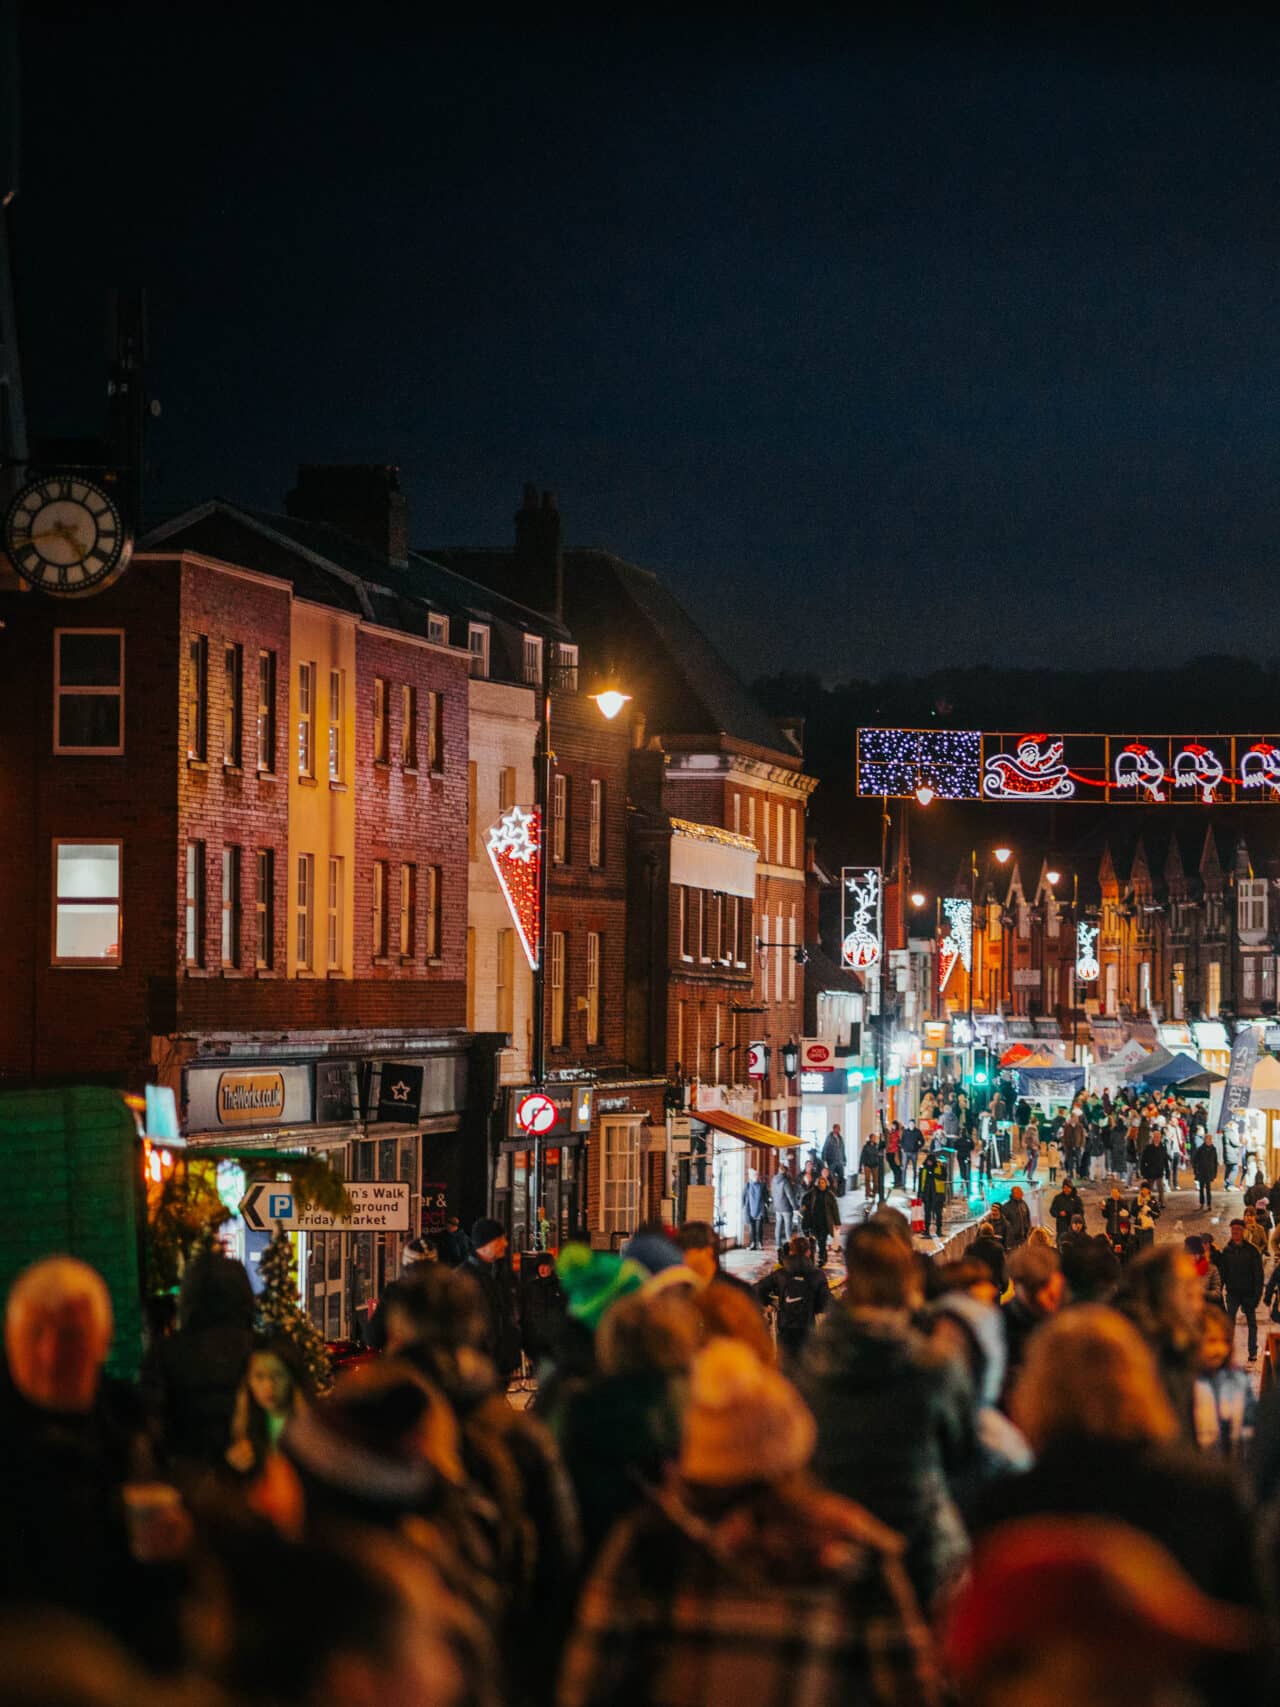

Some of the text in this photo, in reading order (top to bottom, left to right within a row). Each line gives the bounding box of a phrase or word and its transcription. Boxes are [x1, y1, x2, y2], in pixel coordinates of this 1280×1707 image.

[222, 1082, 281, 1110] TheWorks.co.uk
[373, 1188, 404, 1199] Walk
[275, 1197, 289, 1216] P
[298, 1214, 386, 1227] Friday Market
